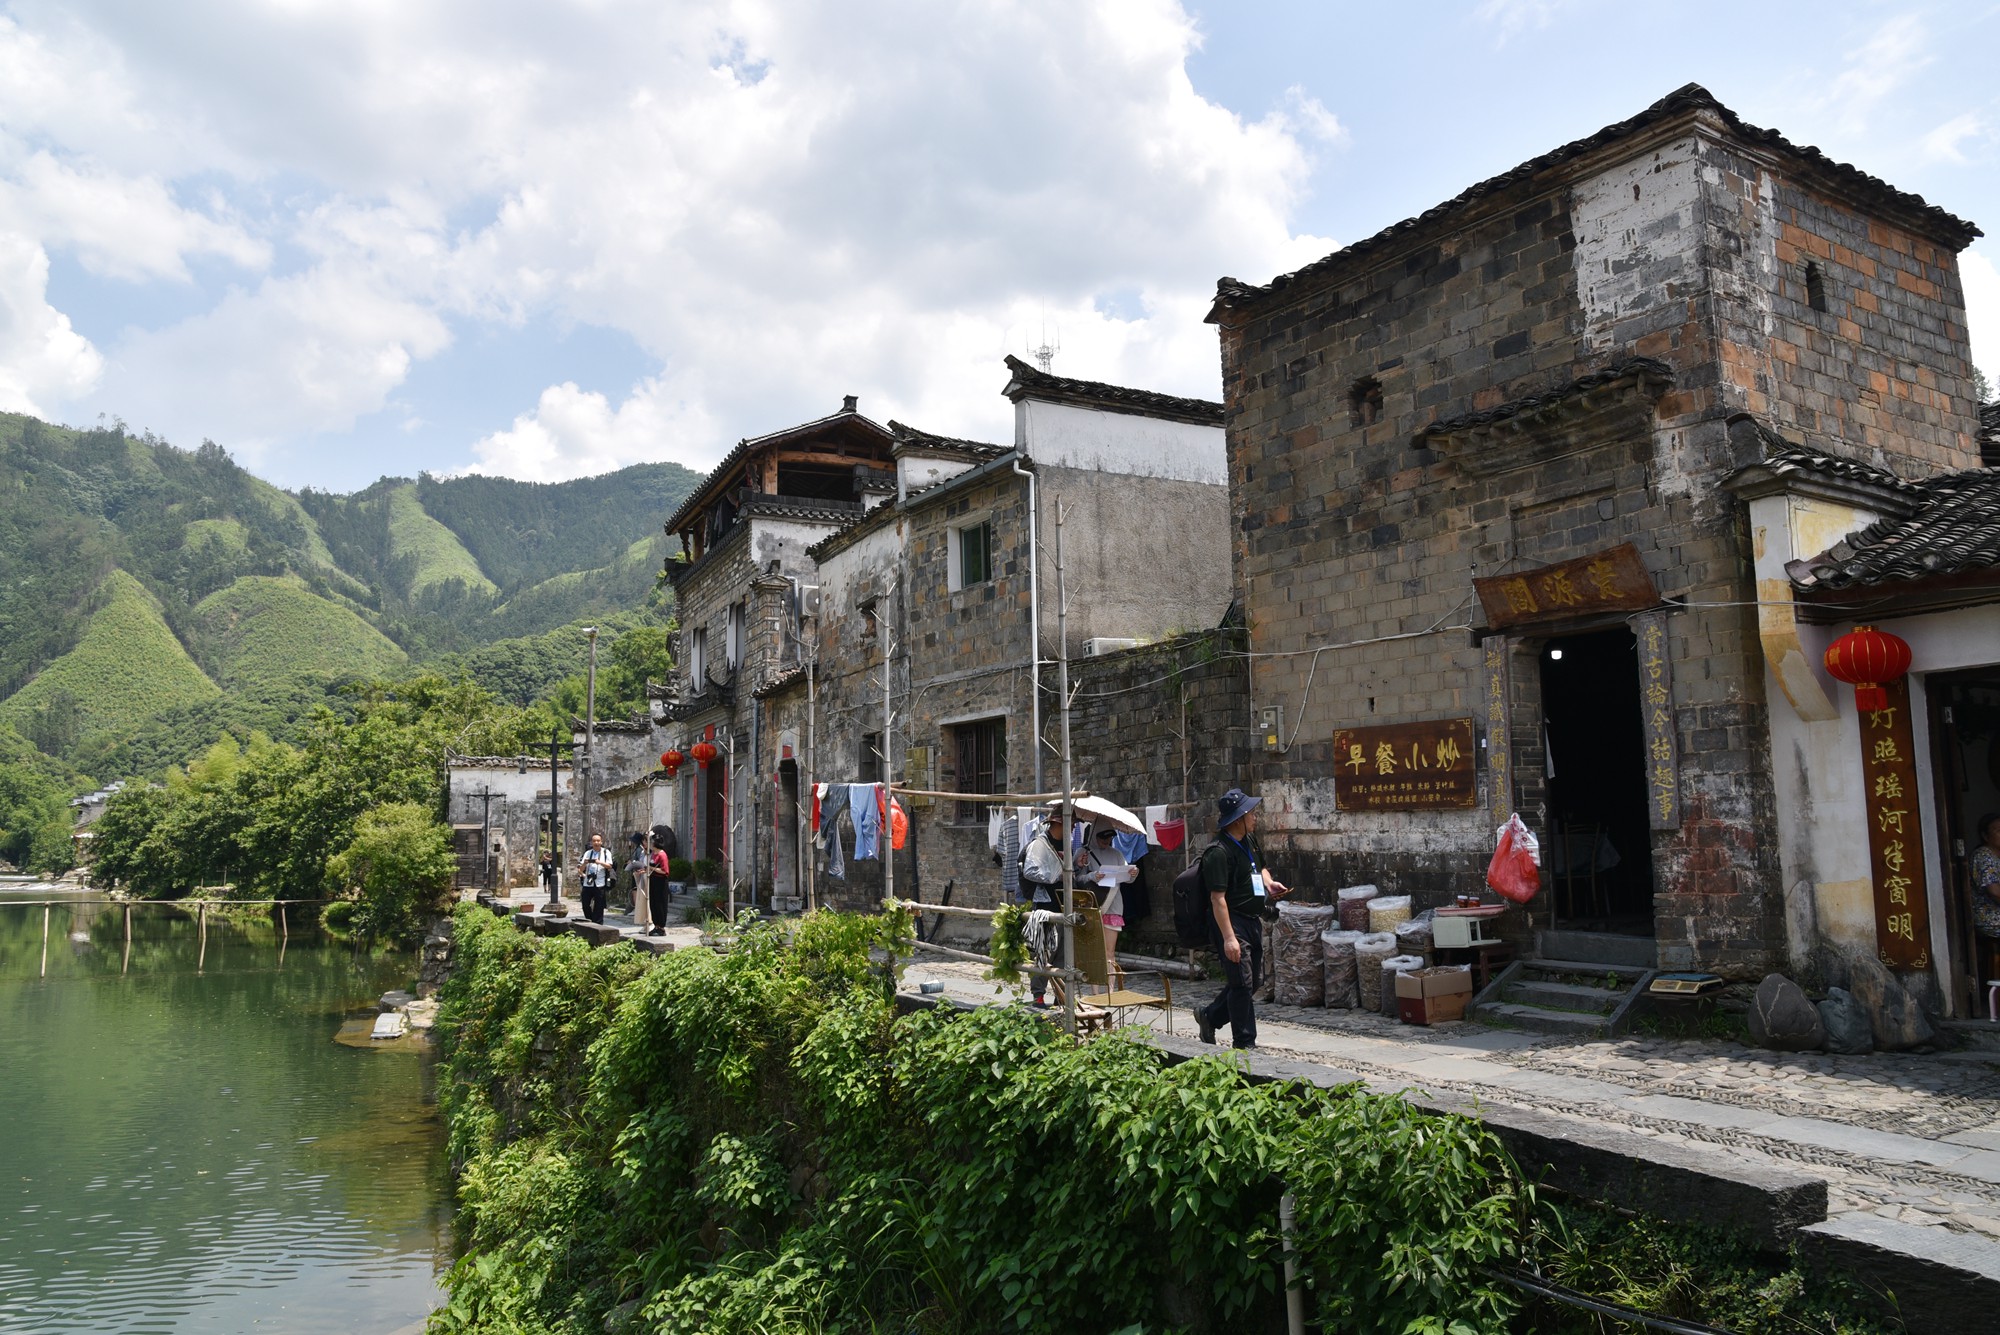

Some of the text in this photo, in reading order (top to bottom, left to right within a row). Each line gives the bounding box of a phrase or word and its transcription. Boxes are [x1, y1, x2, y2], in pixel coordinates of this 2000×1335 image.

[1345, 736, 1461, 776] 早餐小炒
[1870, 705, 1914, 942] 灯照瑶河半窗明
